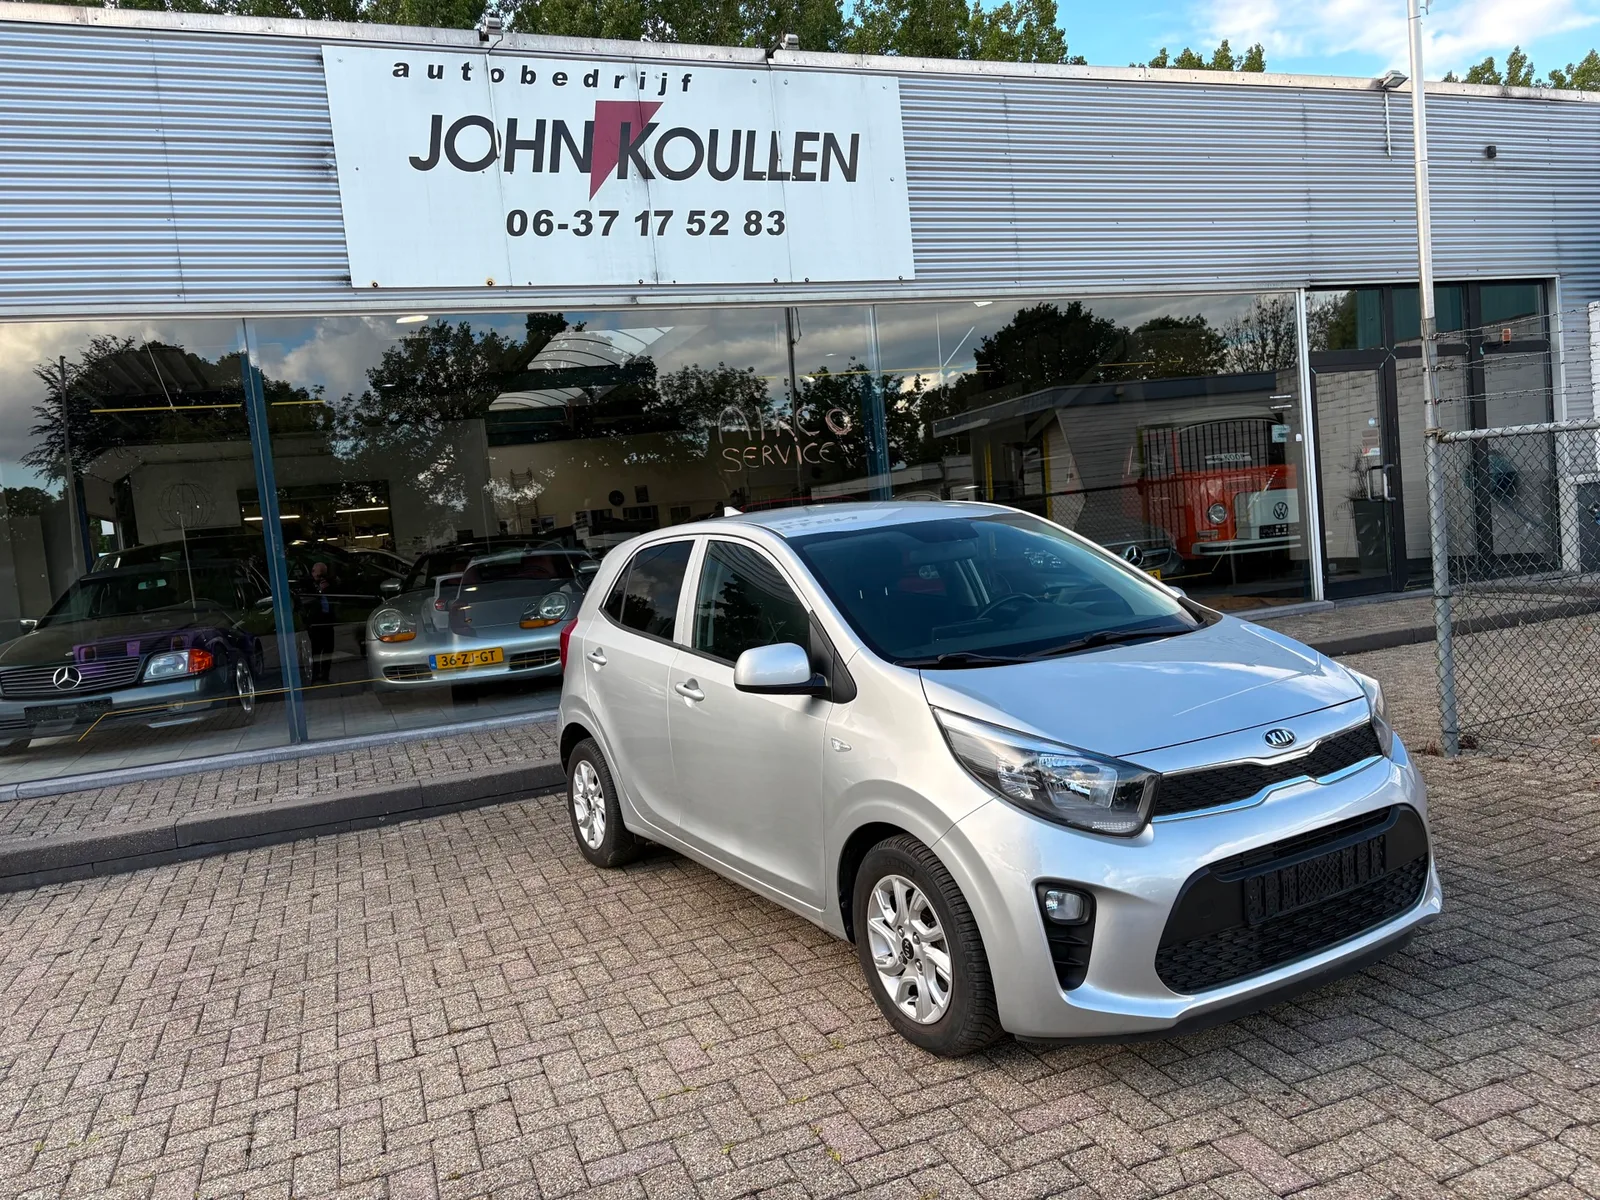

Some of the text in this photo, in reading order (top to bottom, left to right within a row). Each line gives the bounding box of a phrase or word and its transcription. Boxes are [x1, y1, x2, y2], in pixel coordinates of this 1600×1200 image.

[392, 61, 692, 95] autobedrijf
[409, 114, 860, 183] JOHN KOULLEN
[506, 209, 787, 238] 06-37 17 52 83
[722, 440, 837, 473] SERVICE
[441, 650, 496, 667] 36-ZJ-GT
[1266, 729, 1294, 745] KIA
